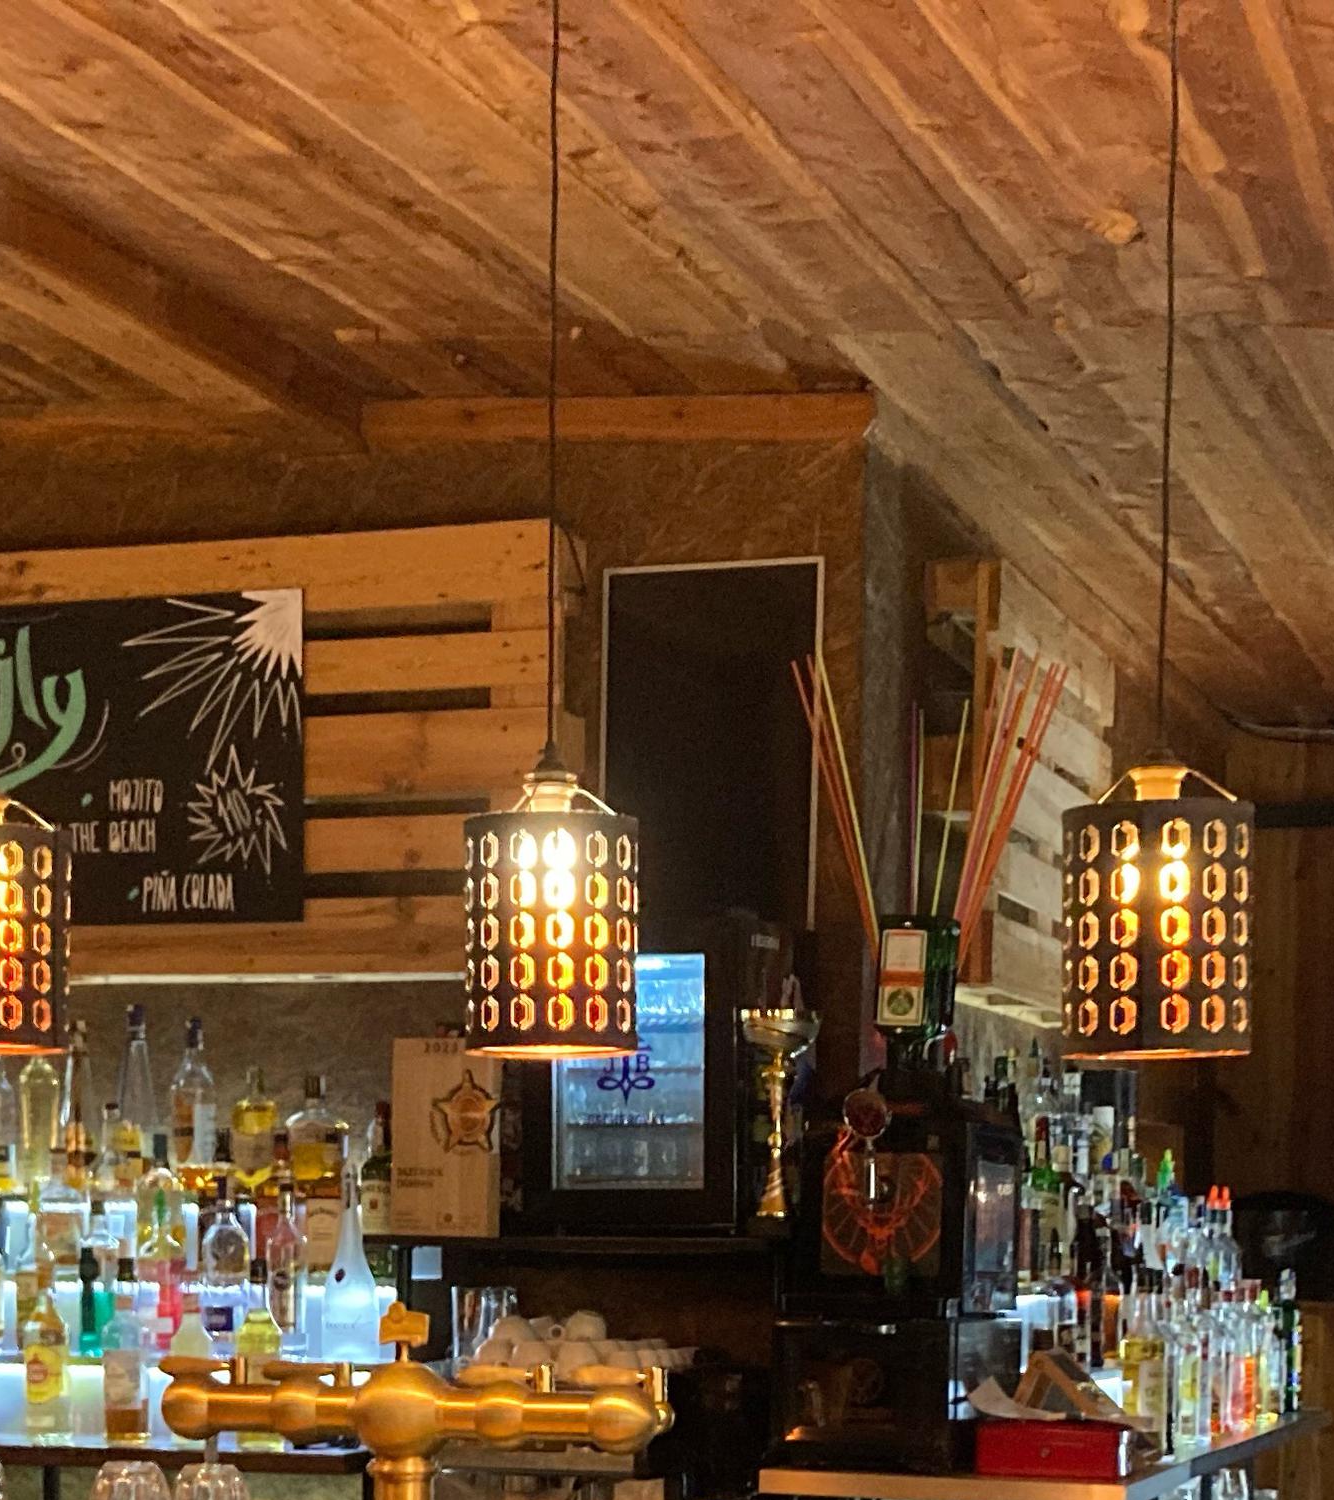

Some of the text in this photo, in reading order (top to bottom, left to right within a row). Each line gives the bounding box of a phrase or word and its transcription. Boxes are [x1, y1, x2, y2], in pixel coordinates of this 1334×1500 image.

[109, 778, 164, 814] MOJITO
[69, 819, 156, 853] THE BEACH
[182, 873, 235, 913] COLADA
